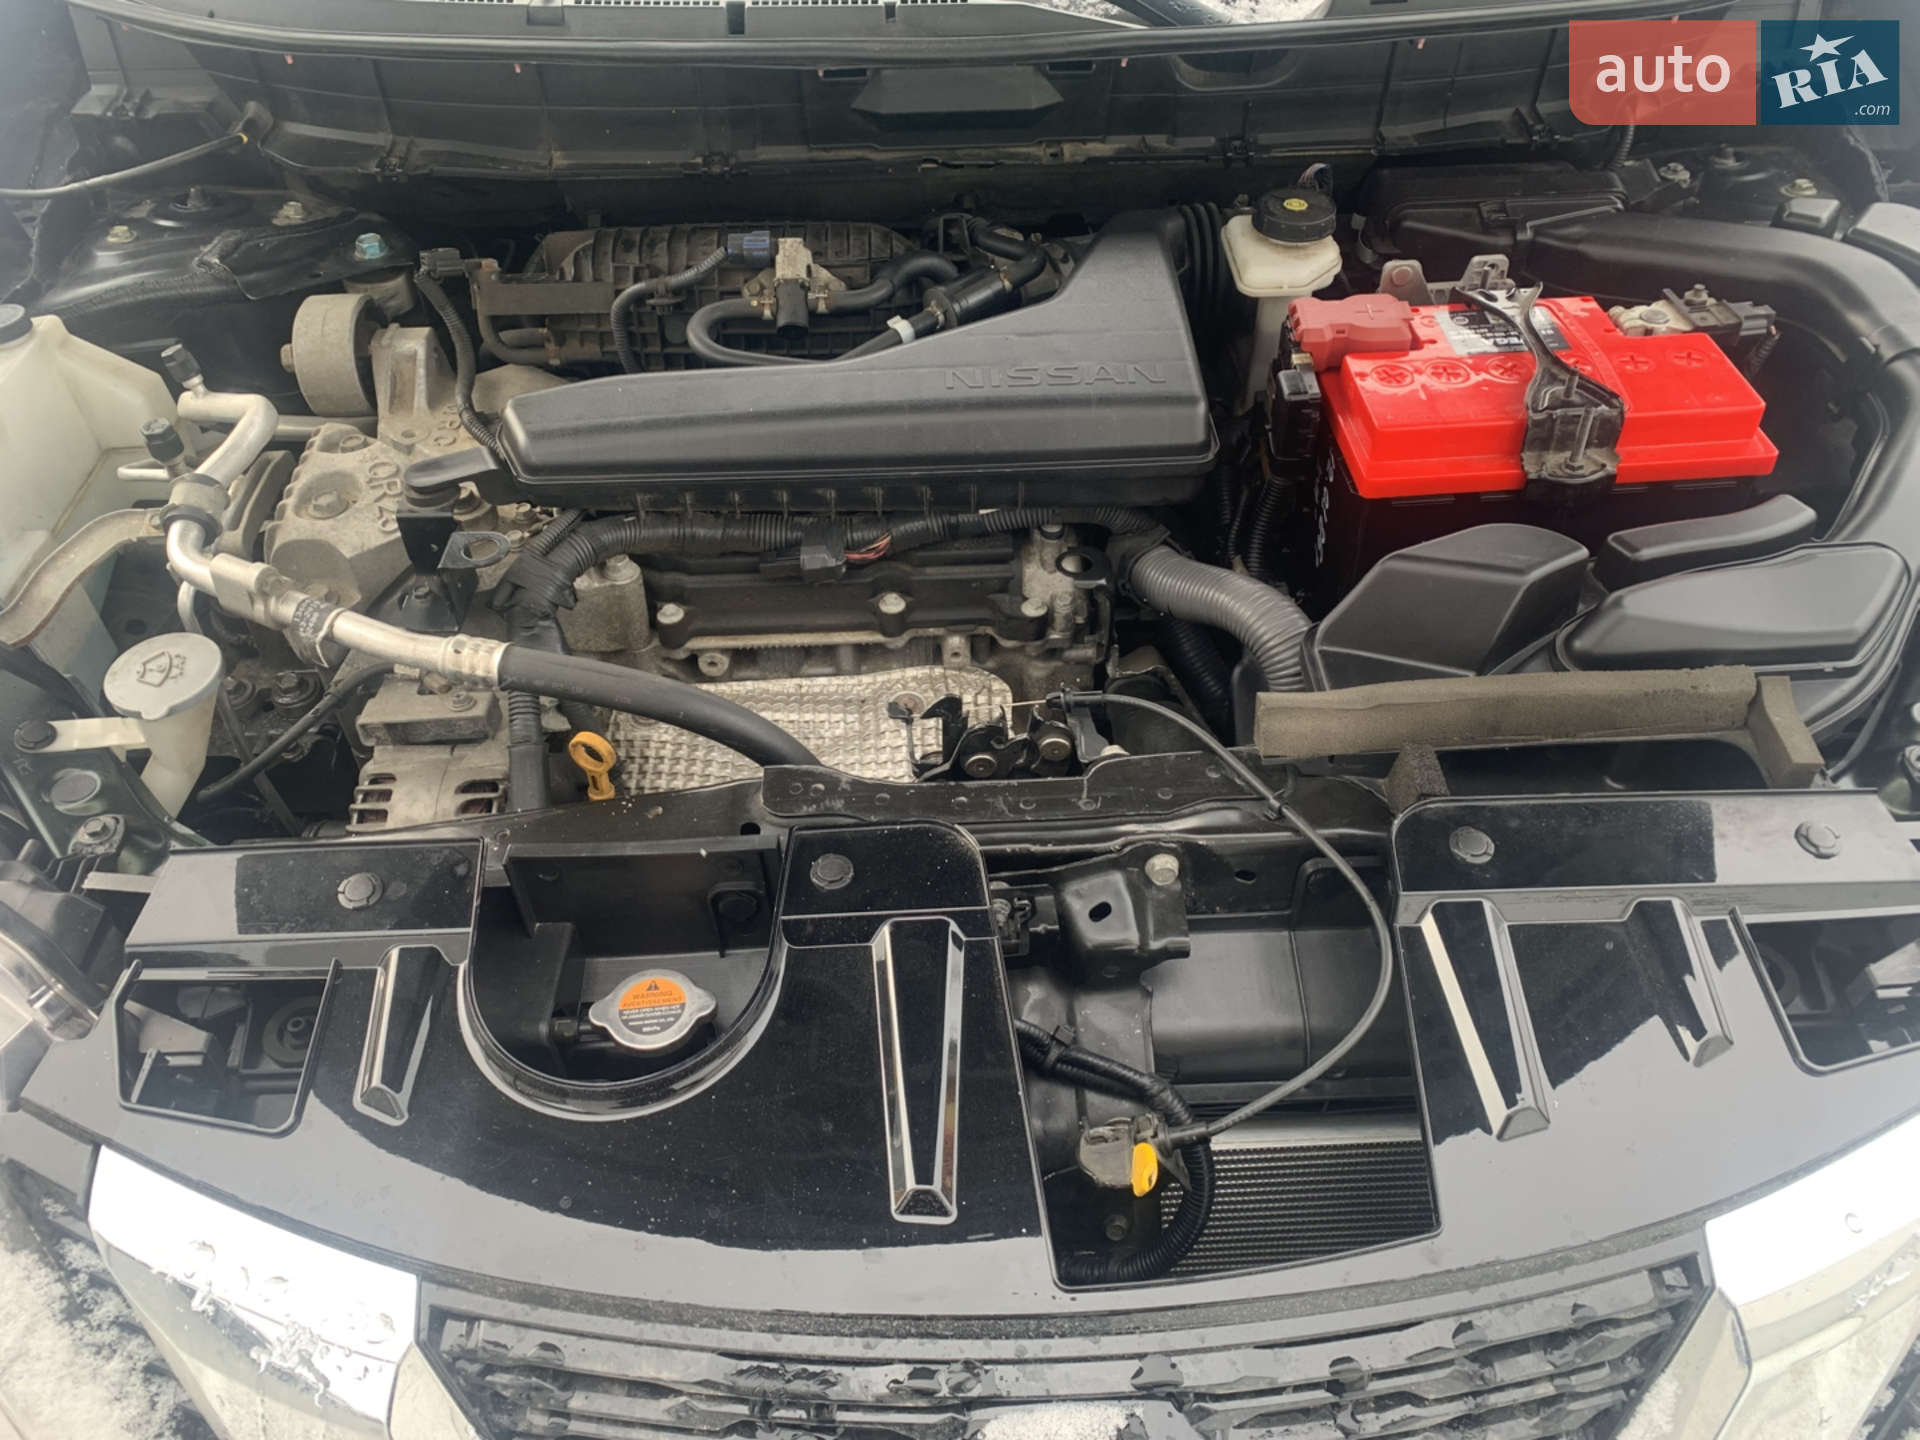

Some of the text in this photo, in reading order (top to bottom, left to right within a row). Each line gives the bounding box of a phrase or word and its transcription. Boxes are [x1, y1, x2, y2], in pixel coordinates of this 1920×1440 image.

[944, 364, 1167, 390] NISSAN
[632, 990, 673, 1000] WARNING
[622, 996, 683, 1008] AVERTISSEMENT
